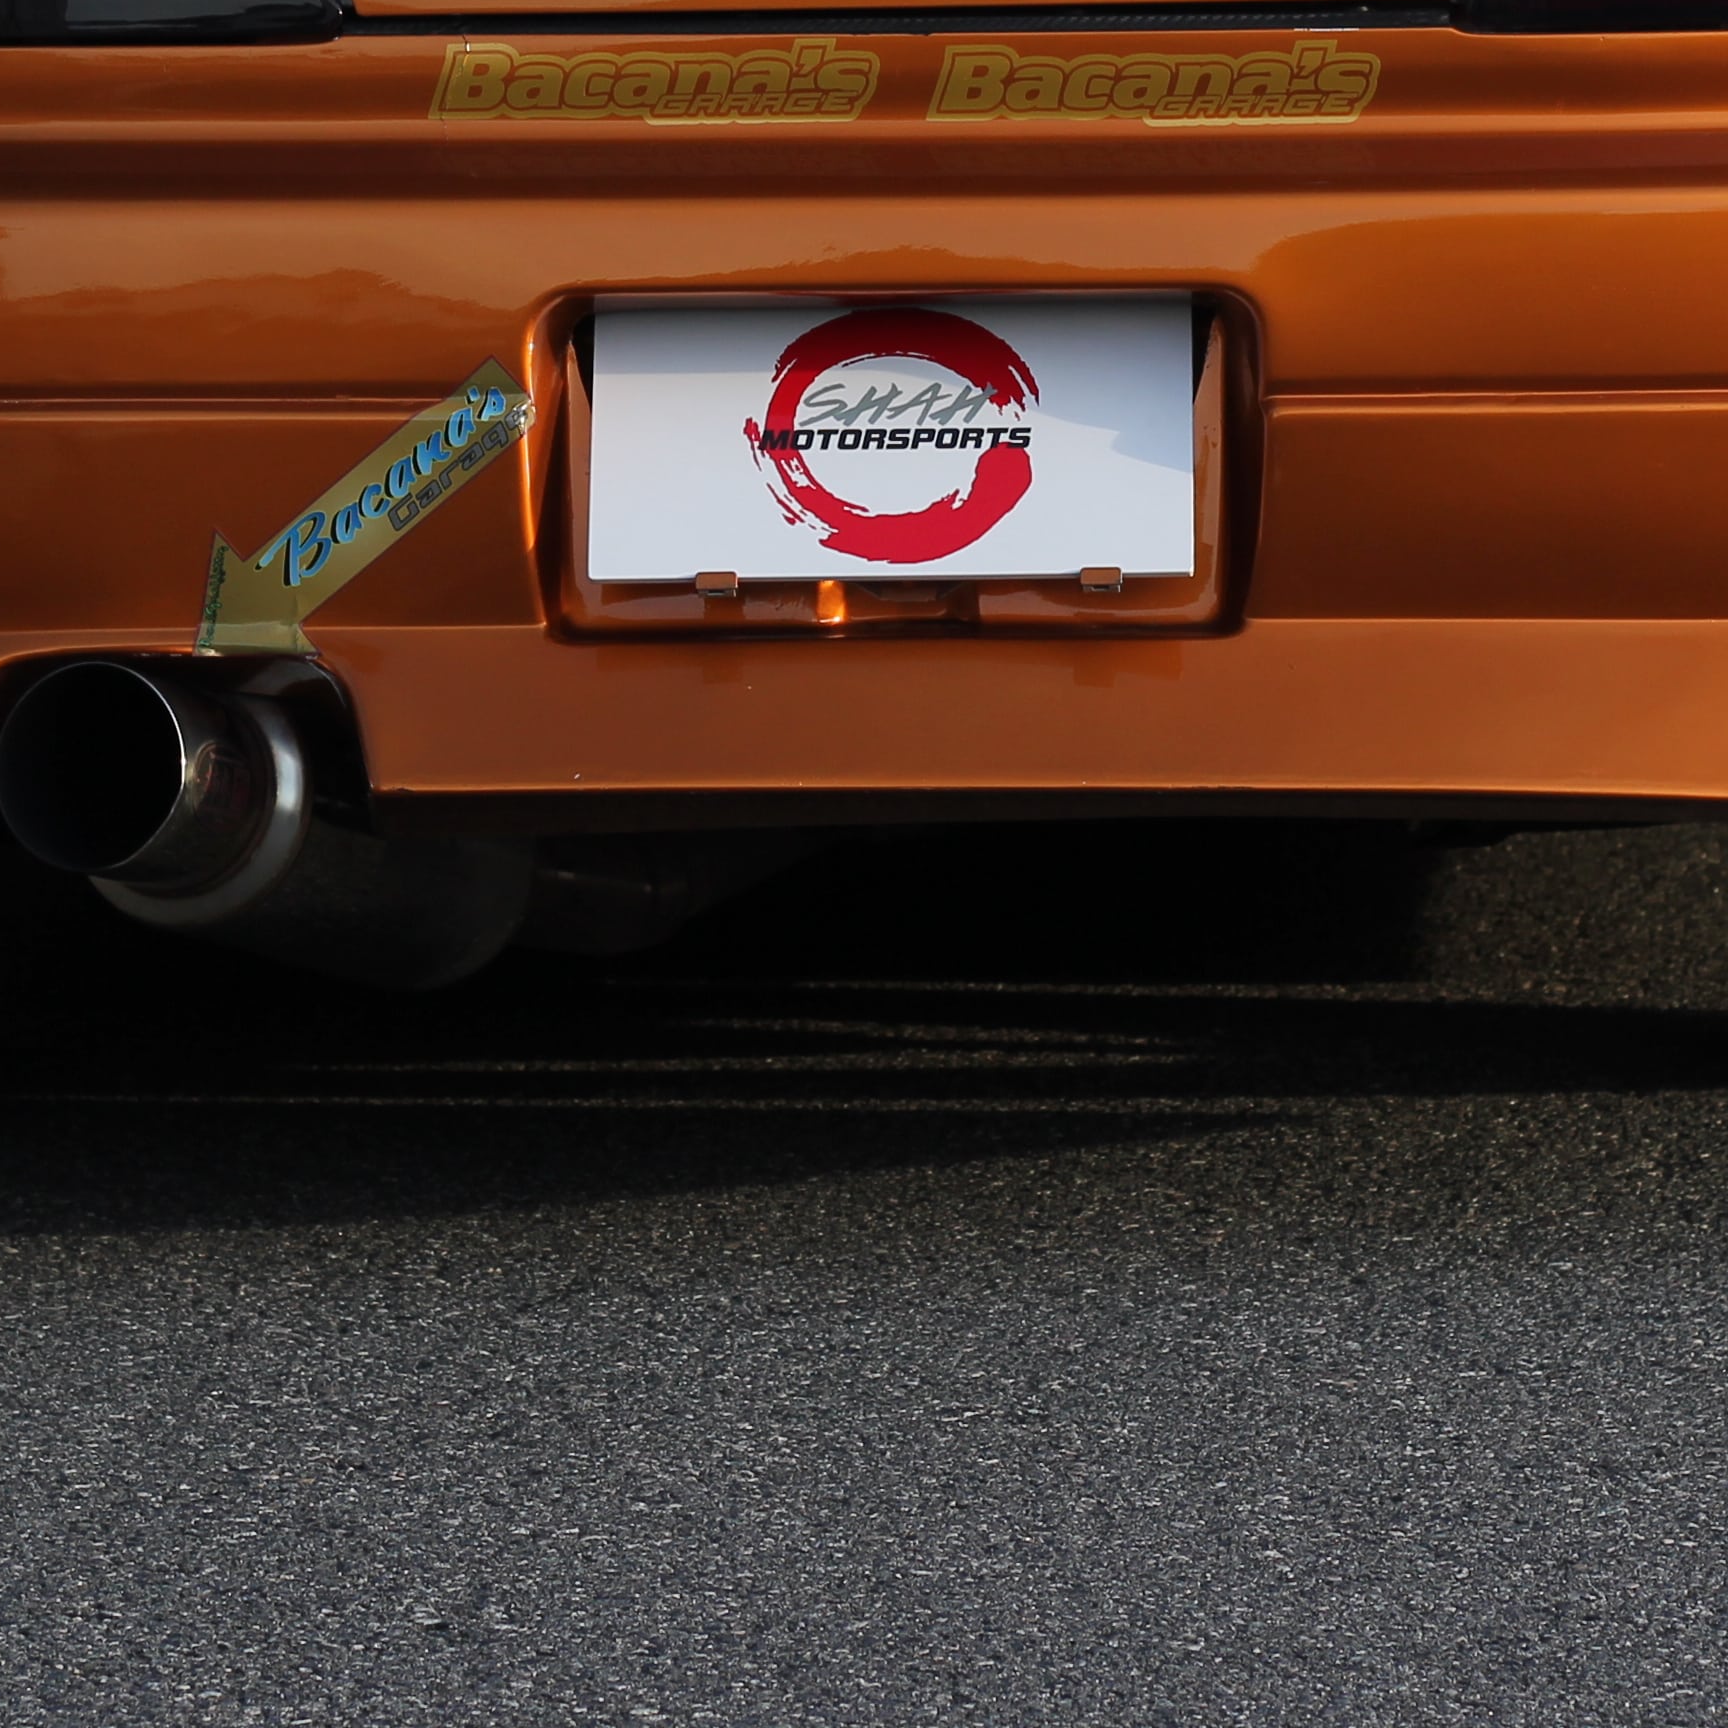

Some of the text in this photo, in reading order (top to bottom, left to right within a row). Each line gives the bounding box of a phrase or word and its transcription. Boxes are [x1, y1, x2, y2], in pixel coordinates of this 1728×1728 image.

[440, 42, 874, 110] Bacana's
[936, 43, 1375, 112] Bacana's
[653, 90, 858, 116] GARAGE
[1152, 91, 1359, 117] GARAGE
[798, 380, 998, 428] SHAH
[757, 425, 1033, 452] MOTORSPORTS
[254, 385, 507, 587] Bacana's
